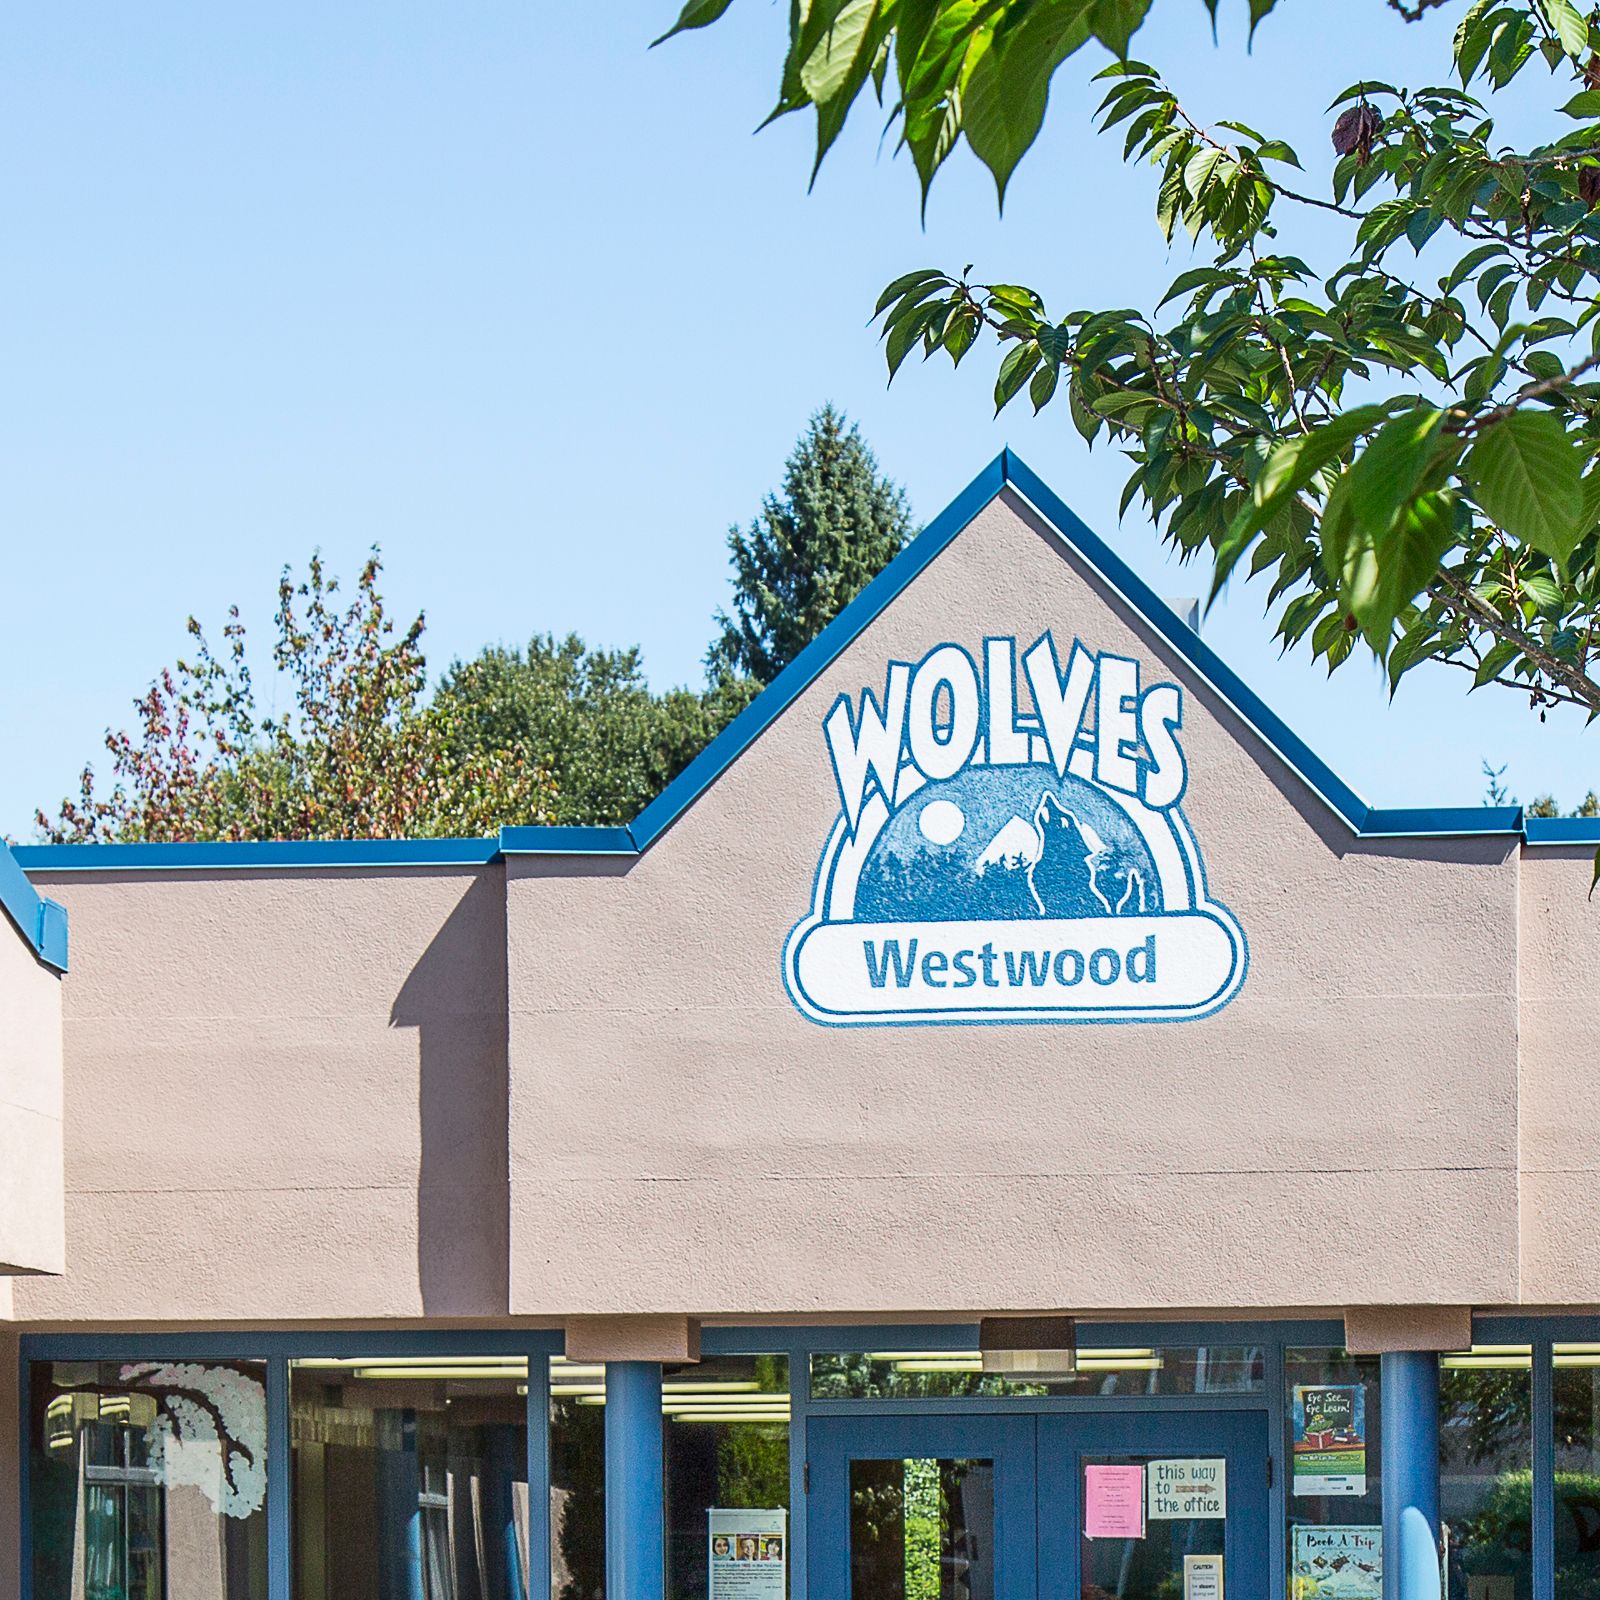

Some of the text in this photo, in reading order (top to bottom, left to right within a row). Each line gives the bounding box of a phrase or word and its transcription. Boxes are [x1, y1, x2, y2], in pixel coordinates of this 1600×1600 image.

[822, 628, 1188, 847] WOLVES
[862, 935, 1156, 988] Westwood
[1307, 1392, 1321, 1404] Eye
[1306, 1400, 1350, 1415] Eye Learn!
[1157, 1465, 1216, 1482] this way
[1155, 1481, 1170, 1494] to
[1154, 1496, 1220, 1512] the office
[1307, 1534, 1375, 1550] Book A Trip
